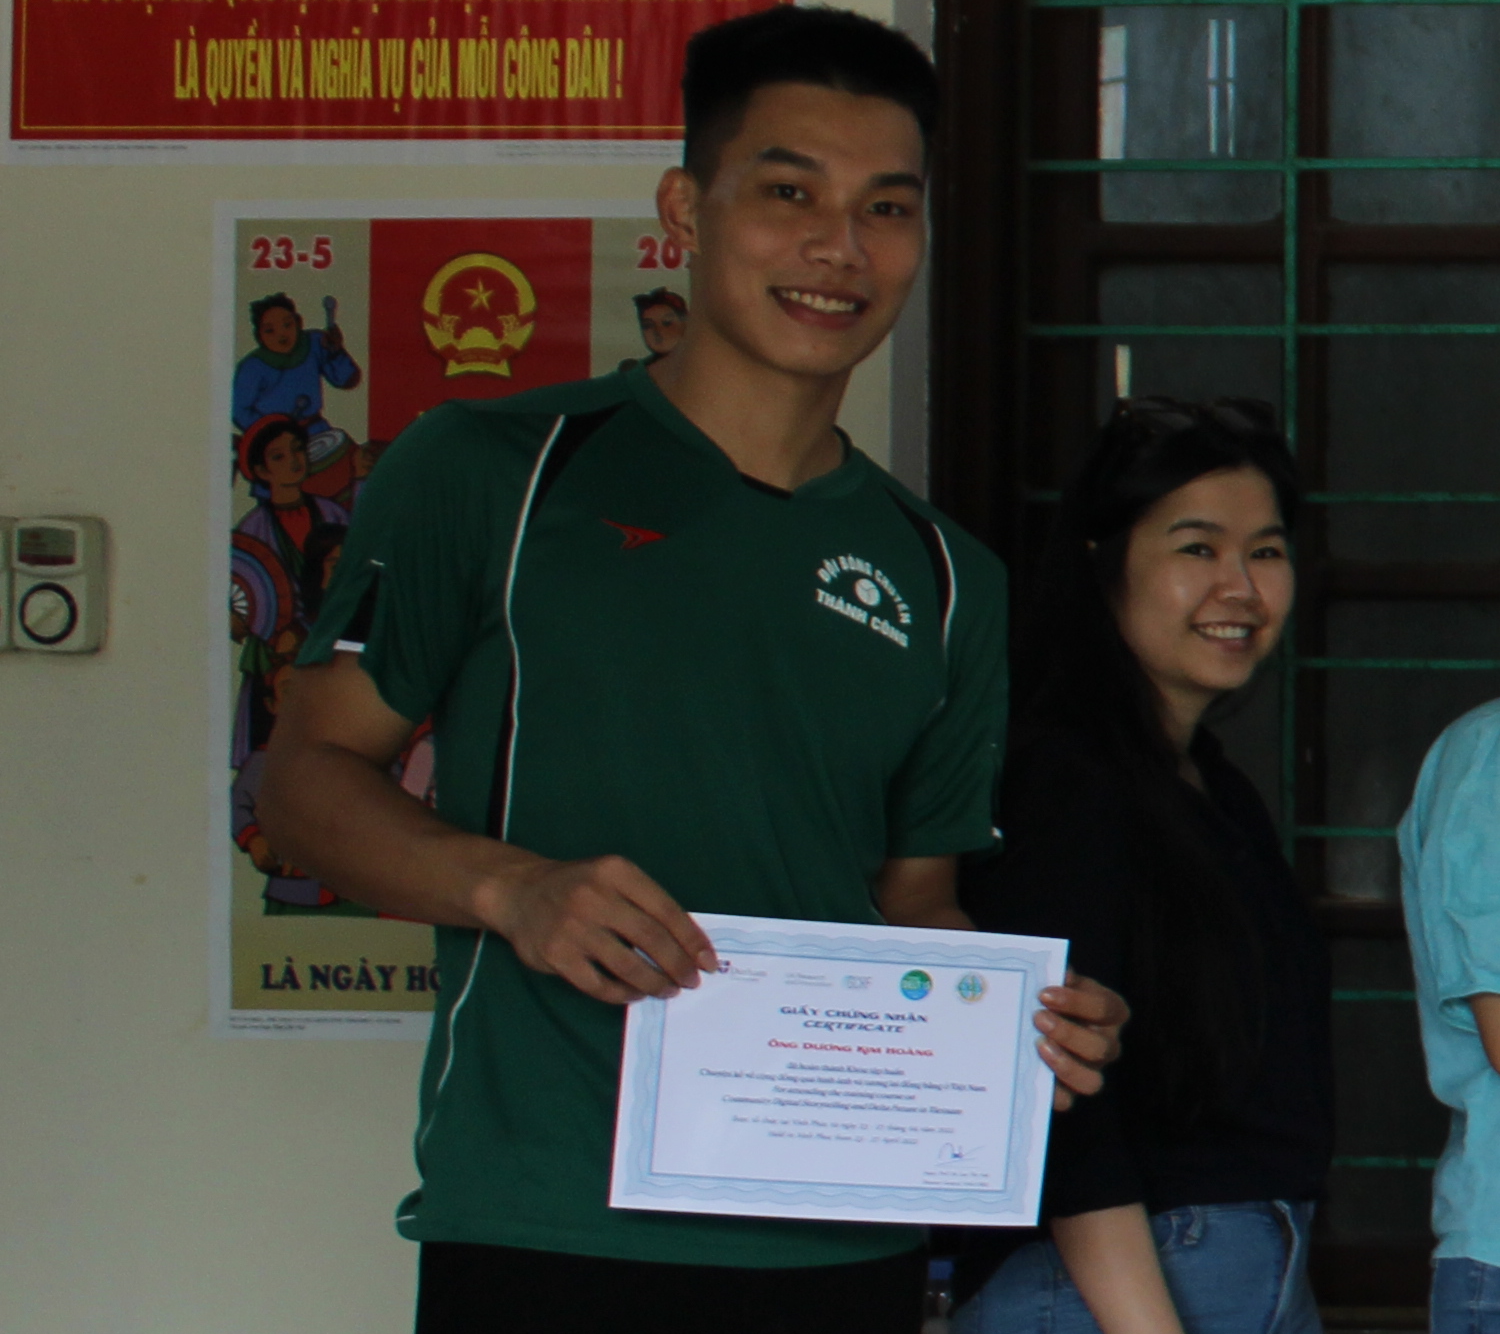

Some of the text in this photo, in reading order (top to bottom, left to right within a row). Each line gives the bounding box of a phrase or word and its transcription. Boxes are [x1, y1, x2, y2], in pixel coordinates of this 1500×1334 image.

[174, 24, 200, 100] LÀ
[206, 17, 273, 106] QUYỀN
[278, 24, 304, 100] VÀ
[310, 26, 373, 100] NGHĨA
[378, 38, 406, 114] VỤ
[410, 16, 451, 100] CỦA
[457, 15, 498, 99] MỖI
[503, 24, 560, 99] CÔNG
[565, 24, 610, 99] DÂN
[250, 234, 334, 270] 23-5
[635, 234, 690, 270] 20
[870, 615, 909, 648] CÔNG
[261, 955, 302, 990] LÀ
[309, 956, 398, 991] NGÀY
[803, 1019, 906, 1034] CERTIFICATE
